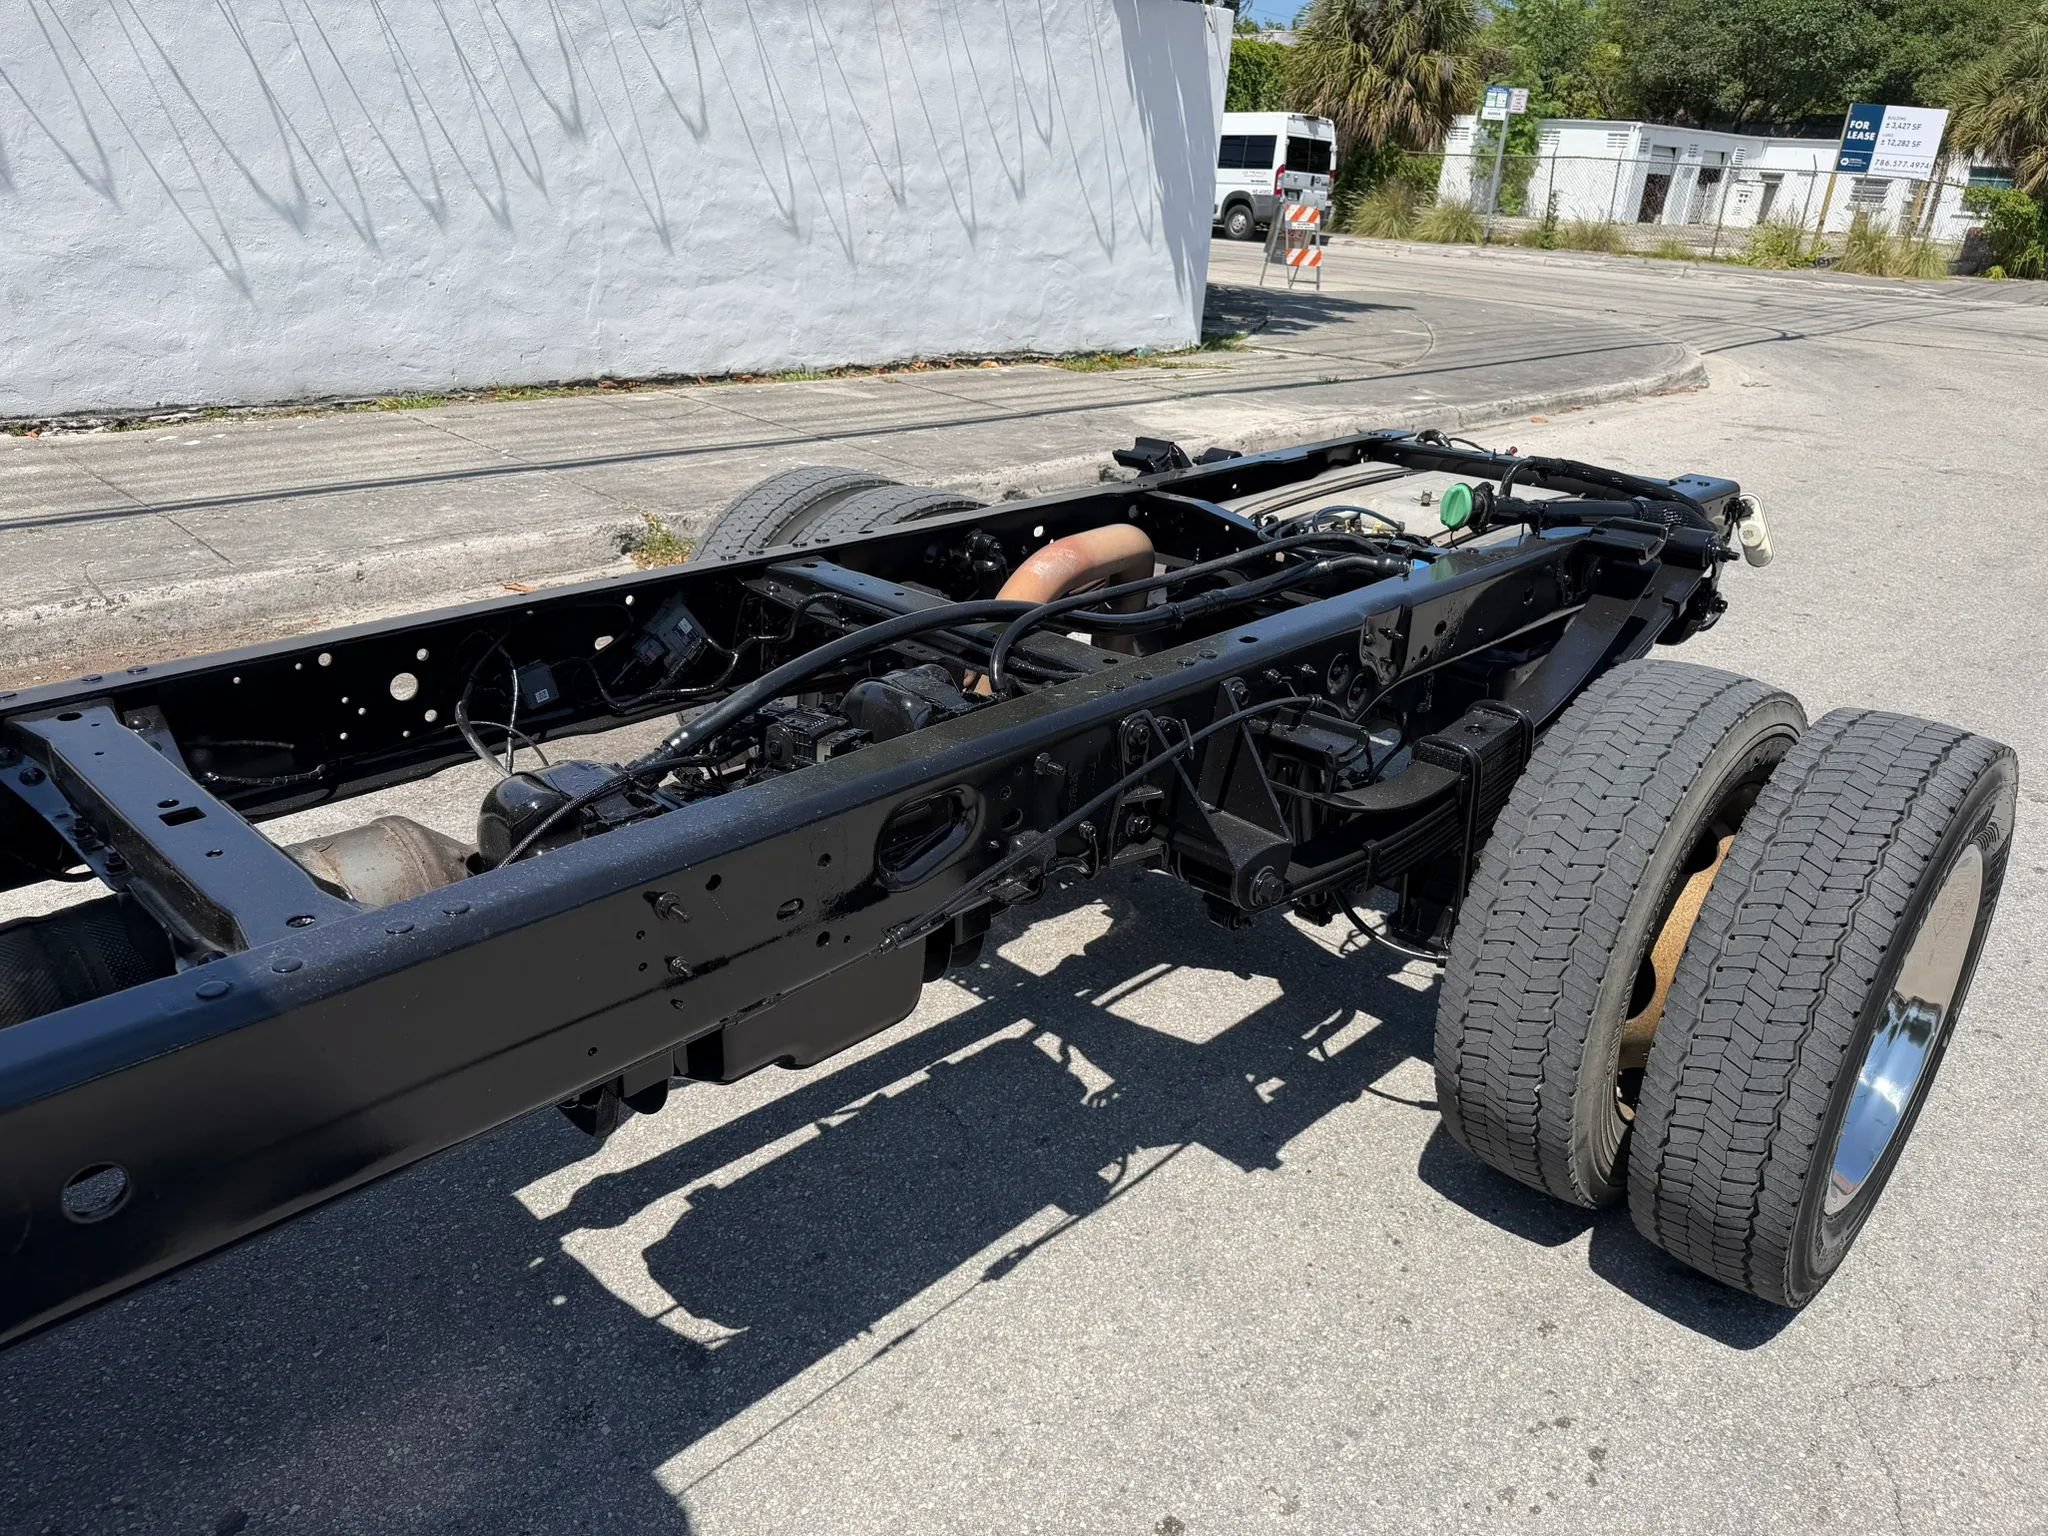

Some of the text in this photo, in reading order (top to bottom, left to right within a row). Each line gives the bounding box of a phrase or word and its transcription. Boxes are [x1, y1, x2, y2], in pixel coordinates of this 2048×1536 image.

[1849, 120, 1870, 130] FOR
[1891, 122, 1911, 130] 3,427
[1912, 123, 1922, 131] SF
[1846, 131, 1877, 141] LEASE
[1887, 139, 1910, 148] 12,282
[1911, 140, 1922, 148] SF
[1874, 159, 1930, 169] 786.577.4974
